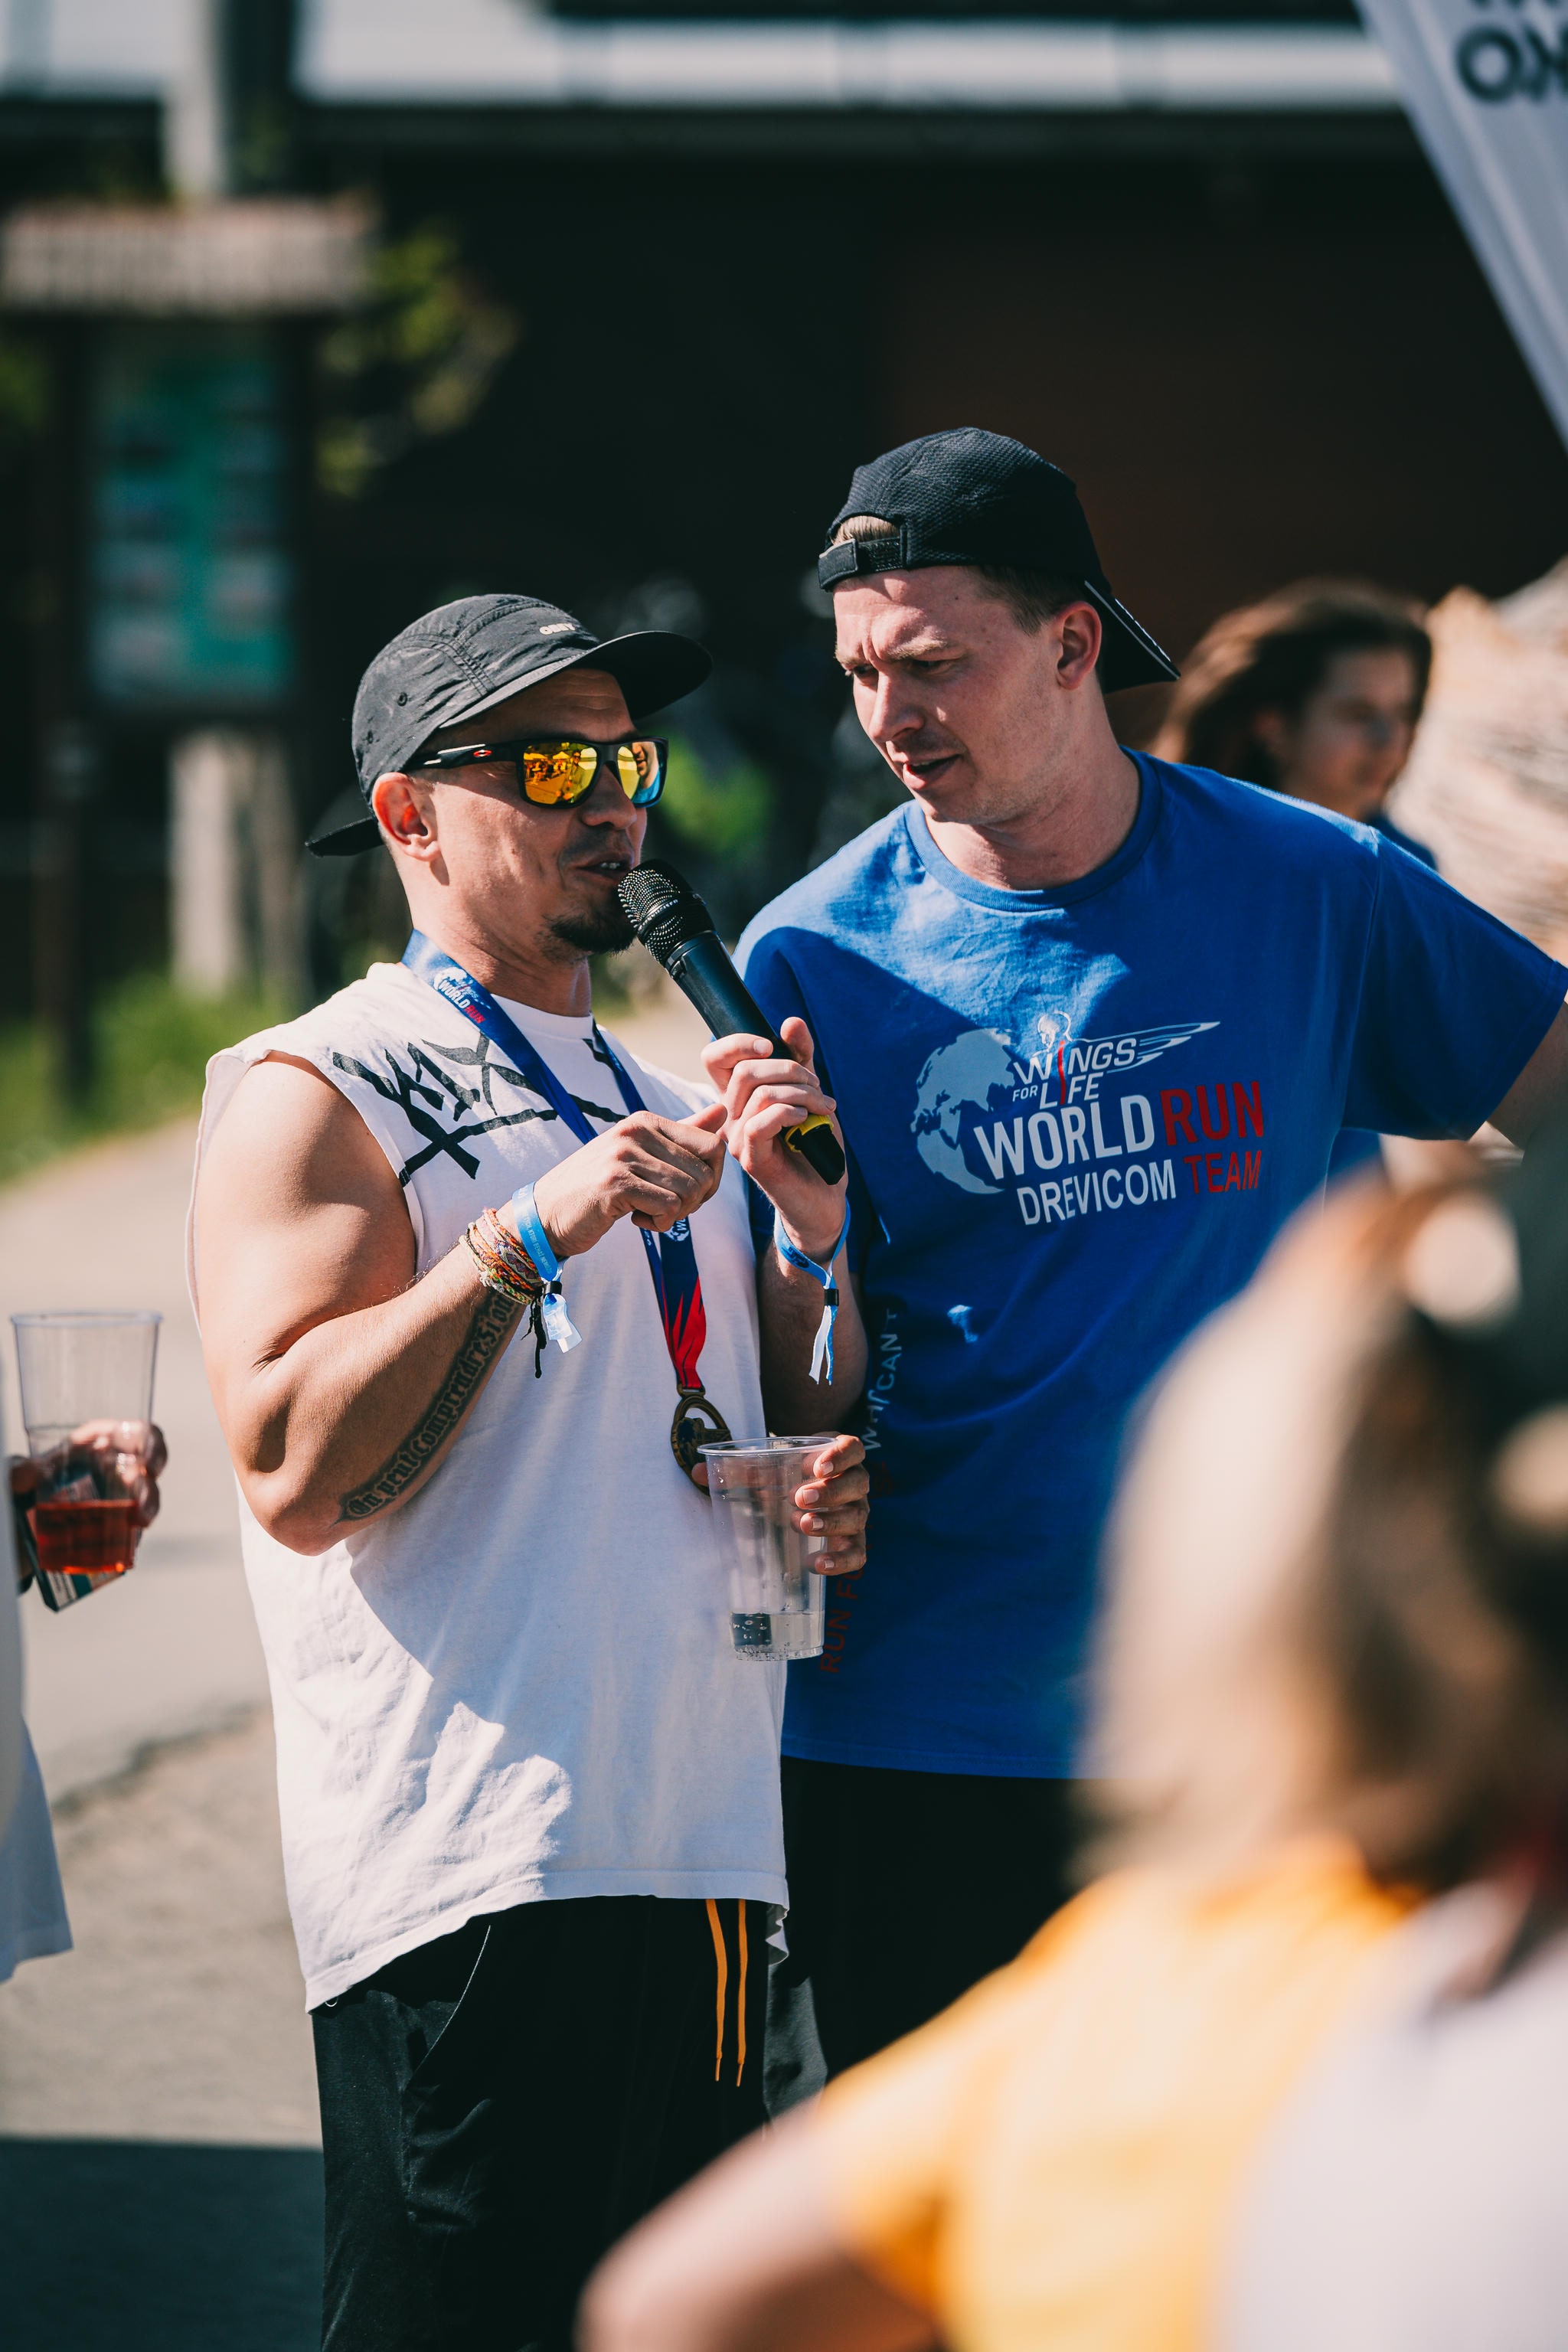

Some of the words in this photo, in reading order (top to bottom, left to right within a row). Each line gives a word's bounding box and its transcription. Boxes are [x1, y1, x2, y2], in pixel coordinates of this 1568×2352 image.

[439, 980, 471, 1008] WORLD
[464, 1004, 485, 1024] RUN
[1013, 1038, 1137, 1085] WINGS
[1012, 1086, 1037, 1102] FOR
[1039, 1073, 1103, 1109] LIFE
[973, 1095, 1155, 1180] WORLD
[1159, 1081, 1264, 1146] RUN
[1017, 1158, 1176, 1225] DREVICOM
[1184, 1150, 1262, 1194] TEAM
[819, 1609, 852, 1674] RUN
